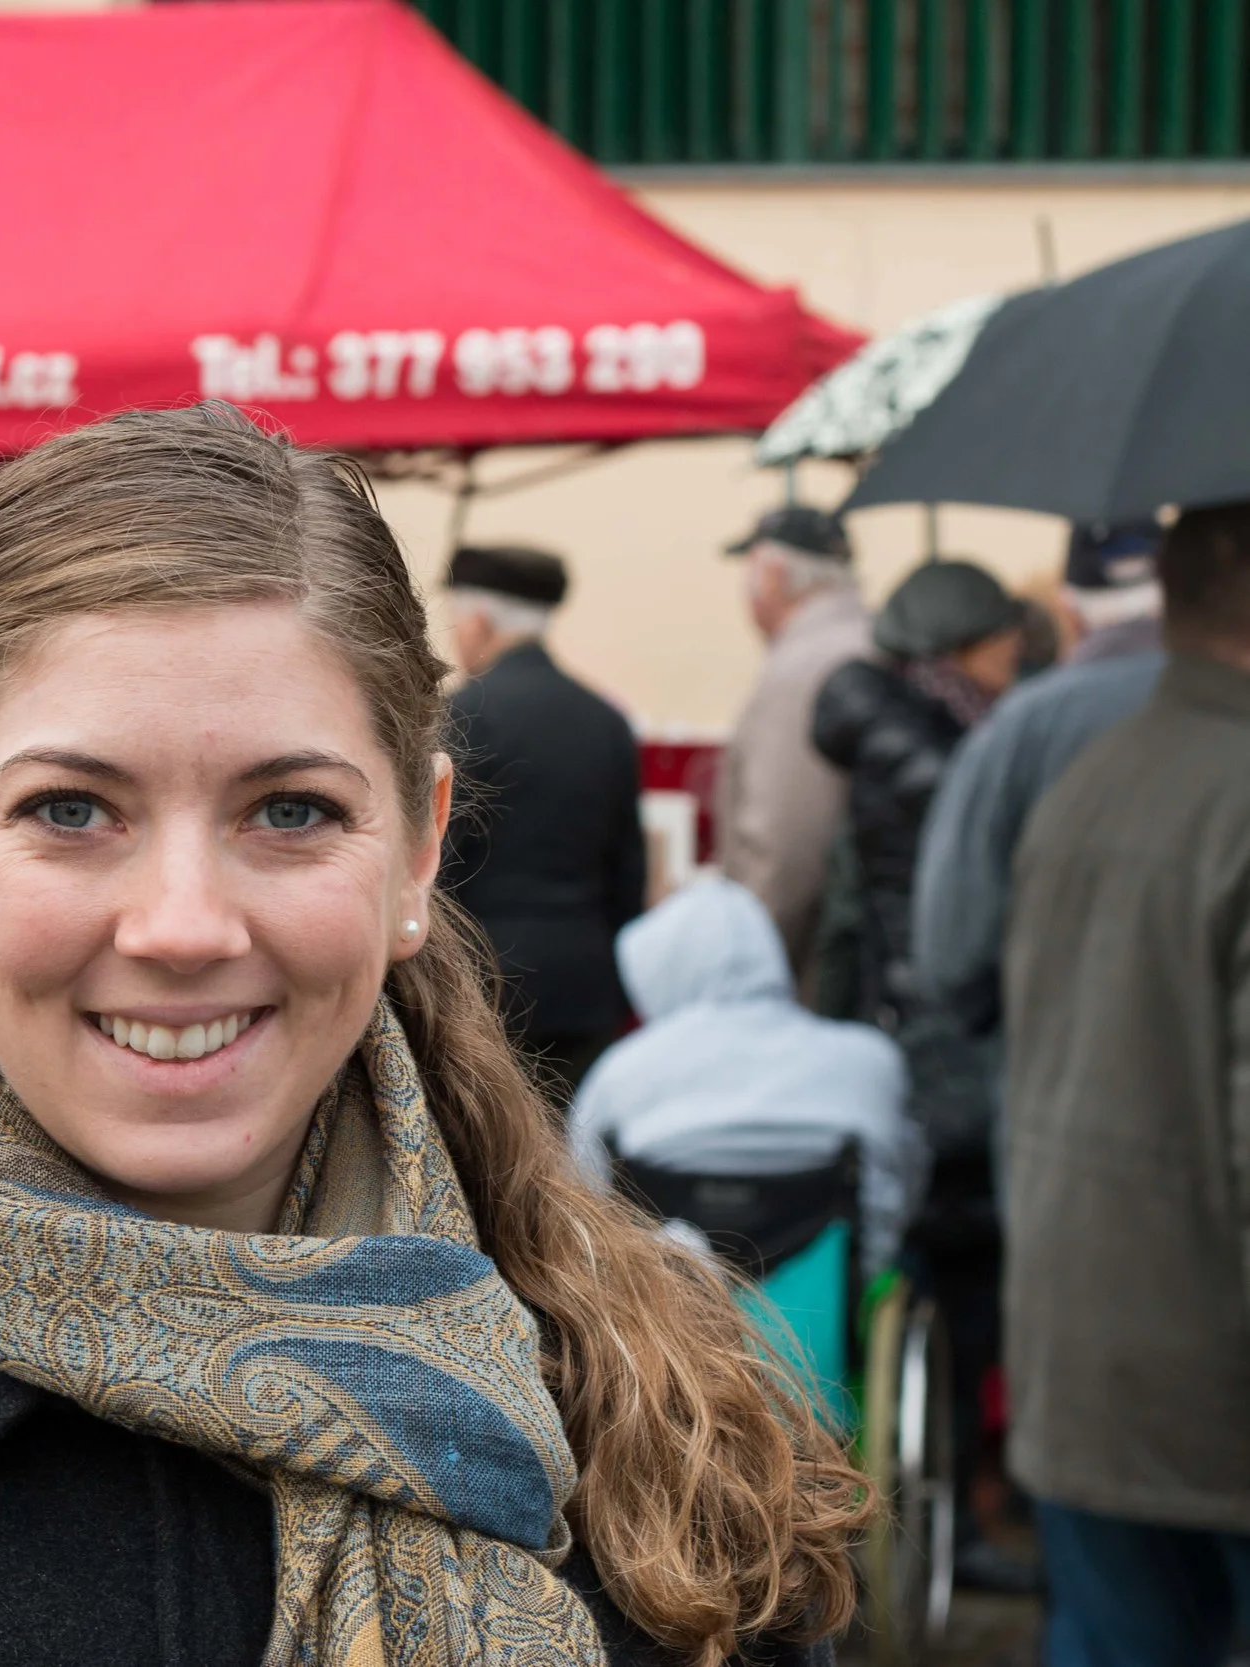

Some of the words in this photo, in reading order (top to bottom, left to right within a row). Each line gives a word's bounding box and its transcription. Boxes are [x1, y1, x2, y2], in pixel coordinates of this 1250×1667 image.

[193, 333, 317, 398] Tel.:
[328, 331, 444, 398] 377
[456, 328, 573, 396] 953
